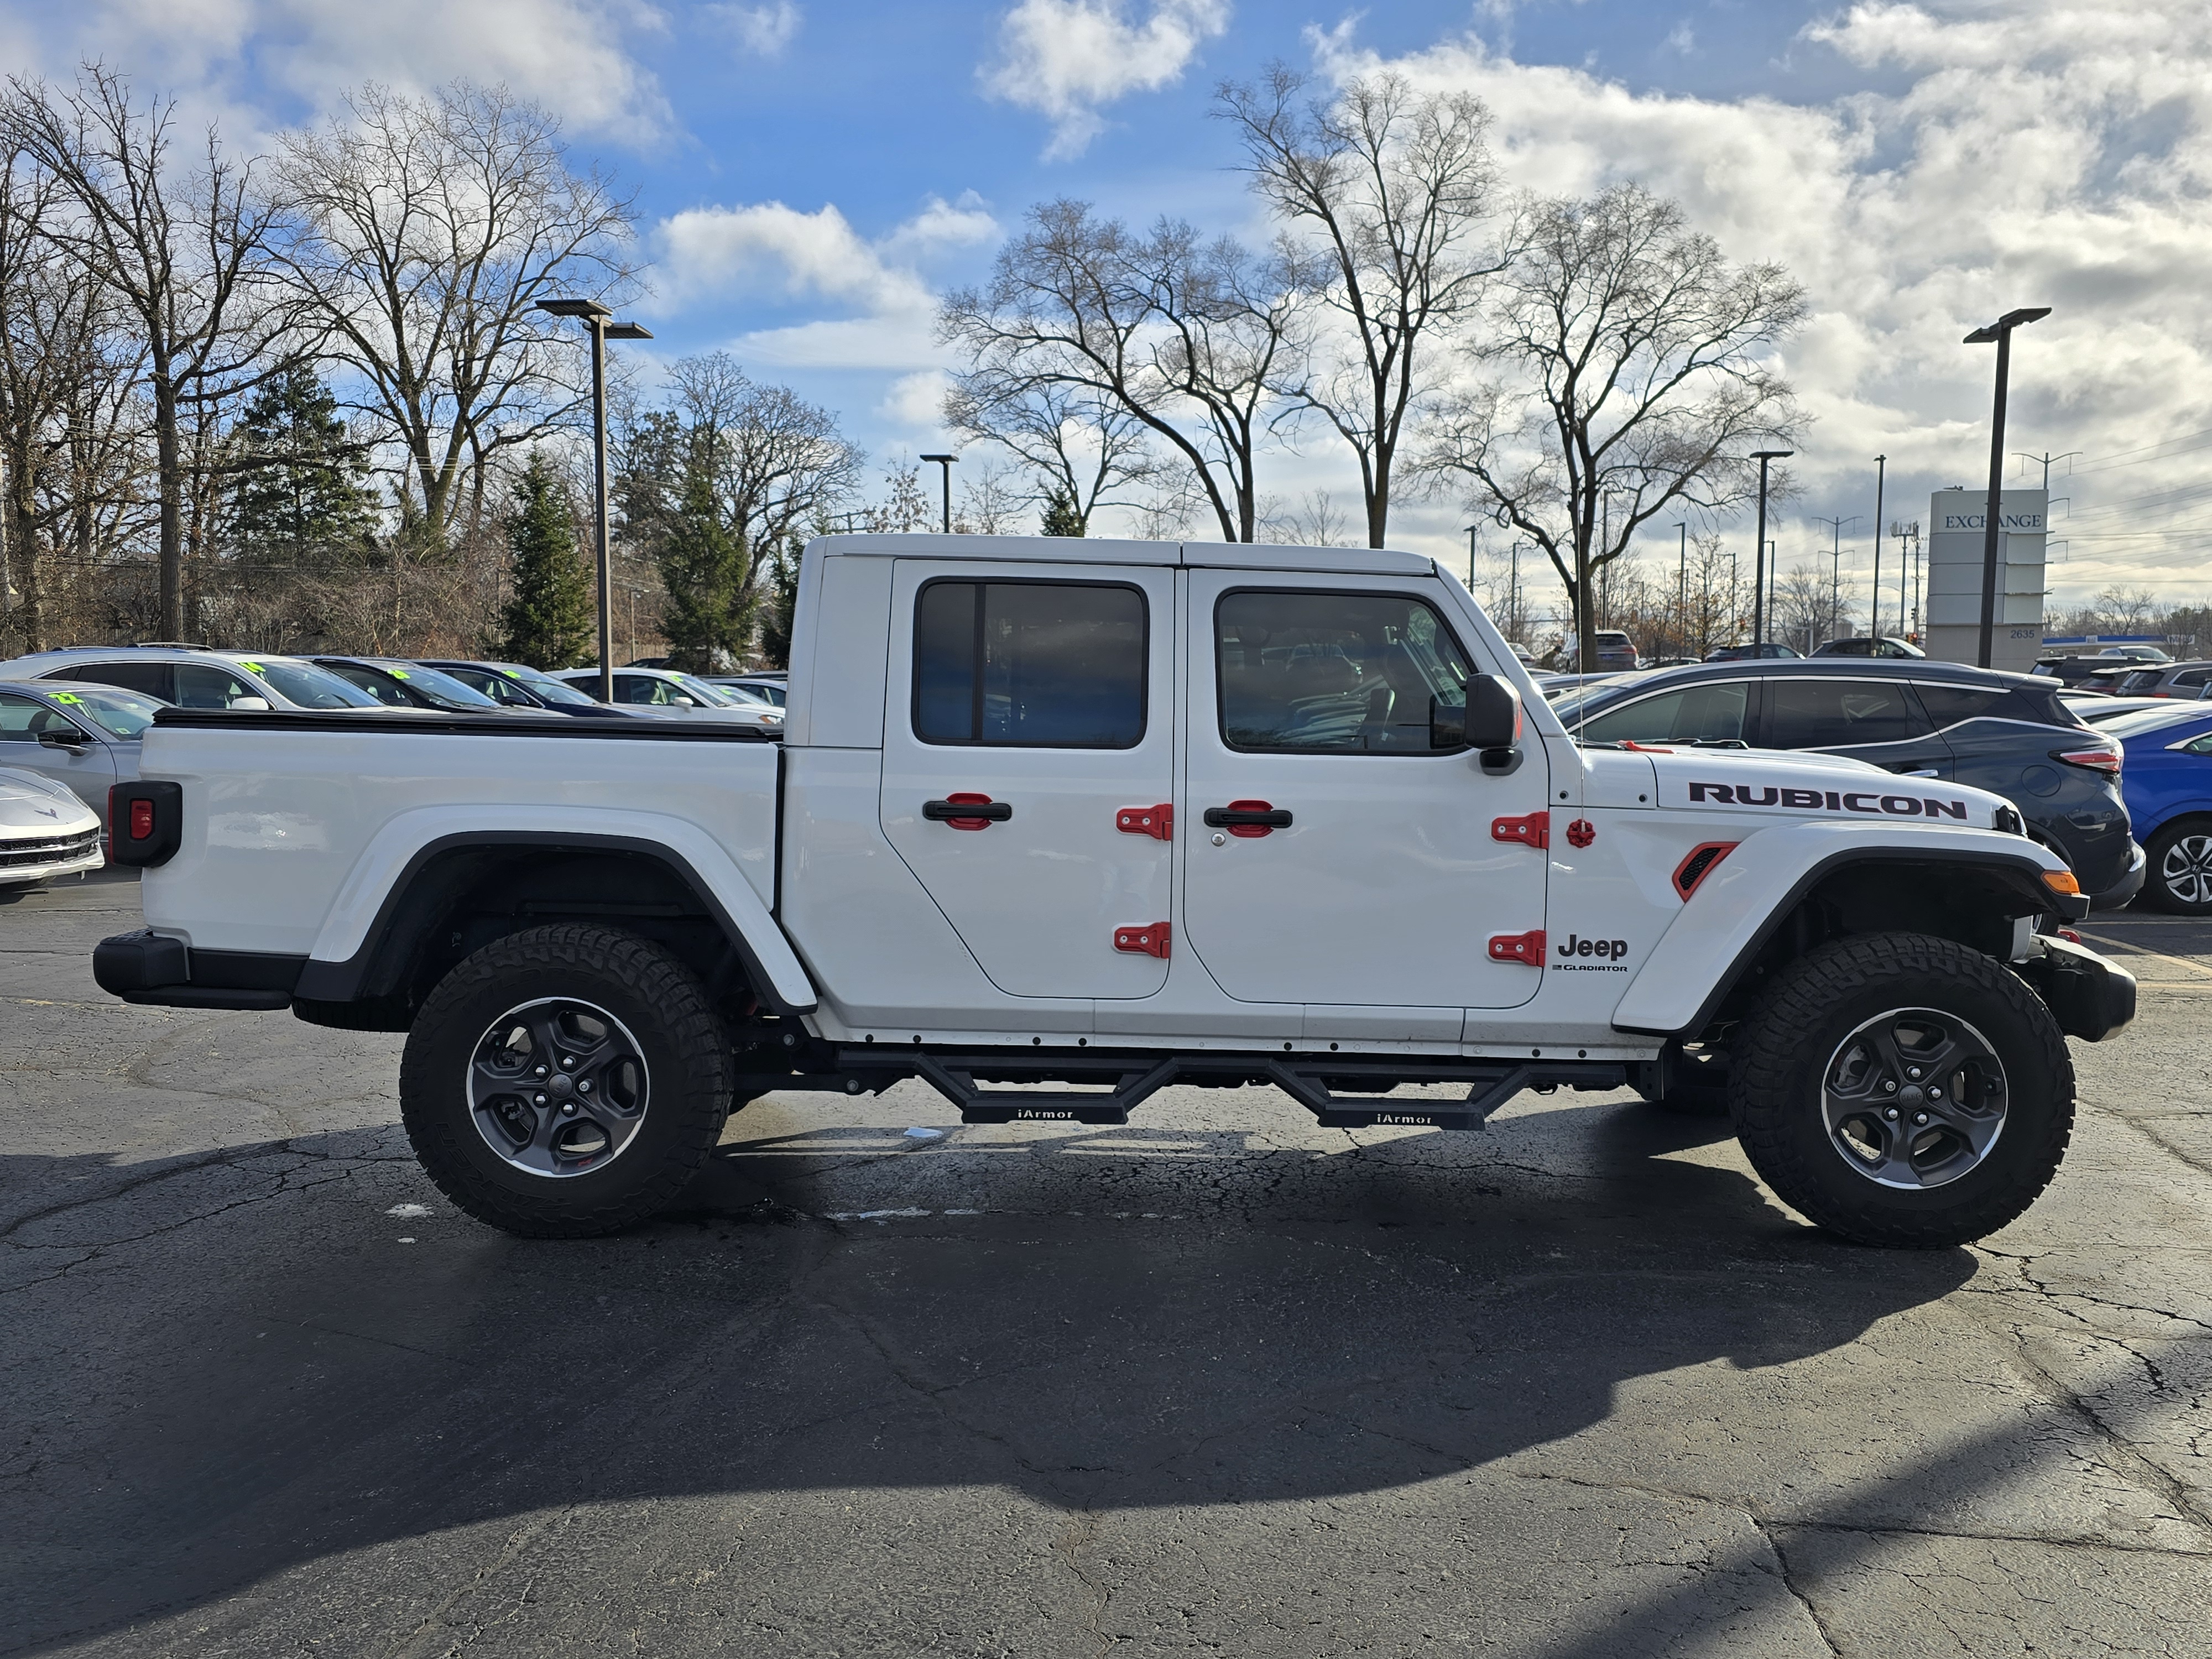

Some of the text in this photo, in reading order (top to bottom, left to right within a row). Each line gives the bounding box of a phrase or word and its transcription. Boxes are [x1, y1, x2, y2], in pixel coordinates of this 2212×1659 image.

[2010, 629, 2034, 639] 2635
[48, 693, 85, 705] 22
[1688, 782, 1968, 820] RUBICON
[1558, 934, 1627, 961] Jeep
[1018, 1109, 1073, 1118] iArmor
[1377, 1114, 1431, 1124] iArmor
